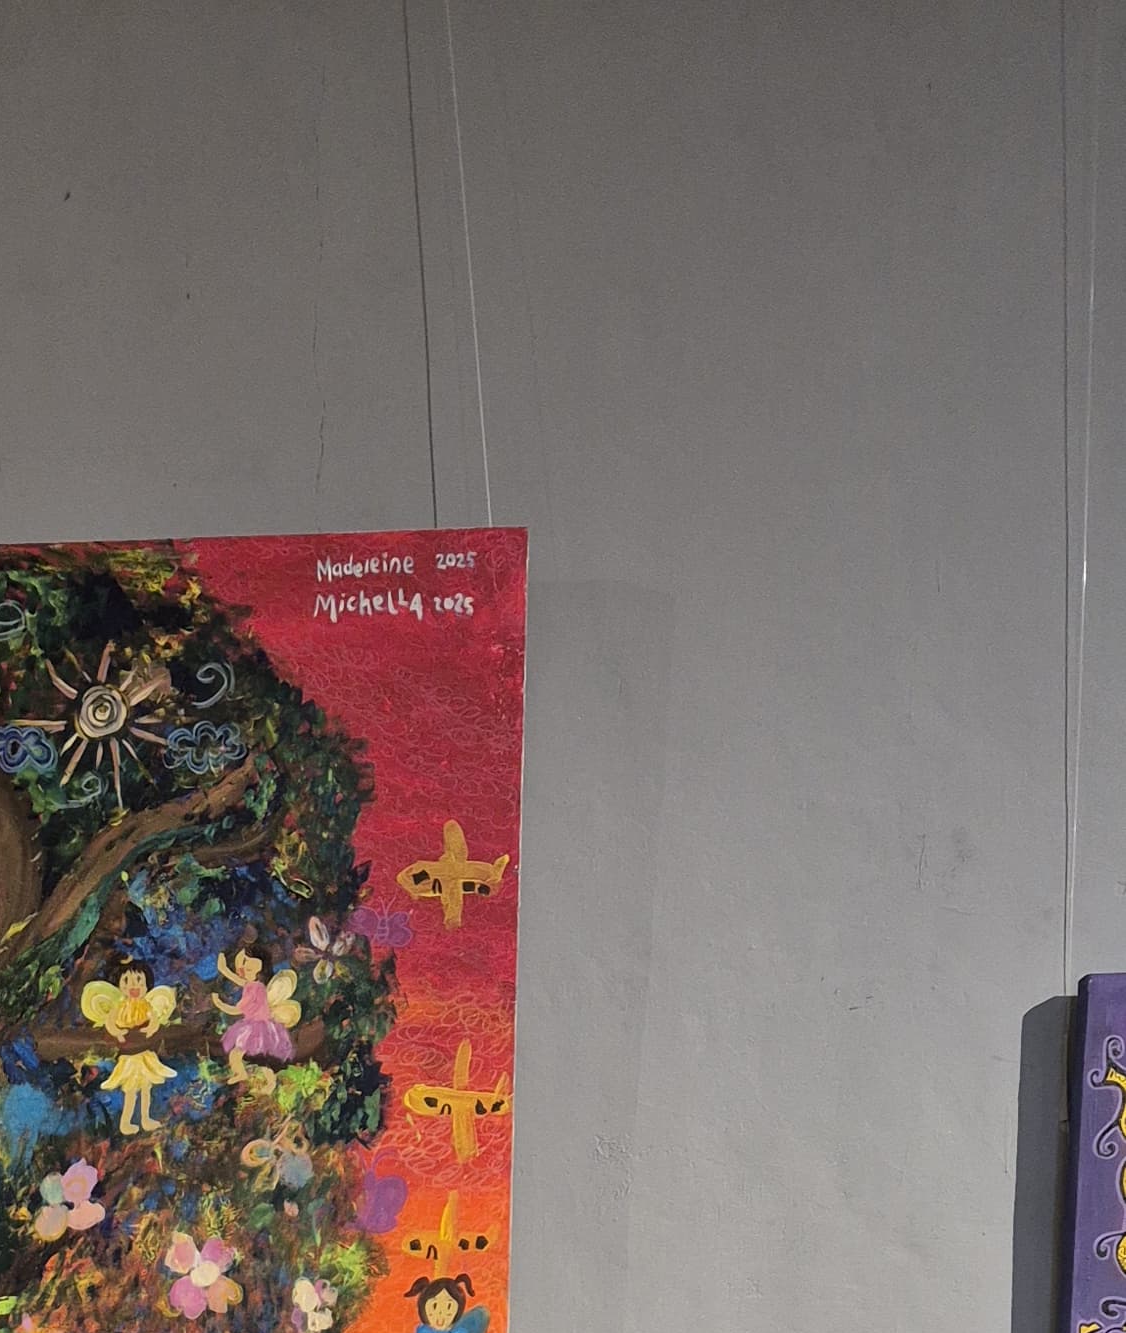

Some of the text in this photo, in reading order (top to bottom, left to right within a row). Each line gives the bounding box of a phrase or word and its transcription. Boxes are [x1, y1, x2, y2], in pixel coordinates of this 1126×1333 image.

[316, 551, 477, 583] Madeleine 2025
[433, 592, 475, 616] 2025
